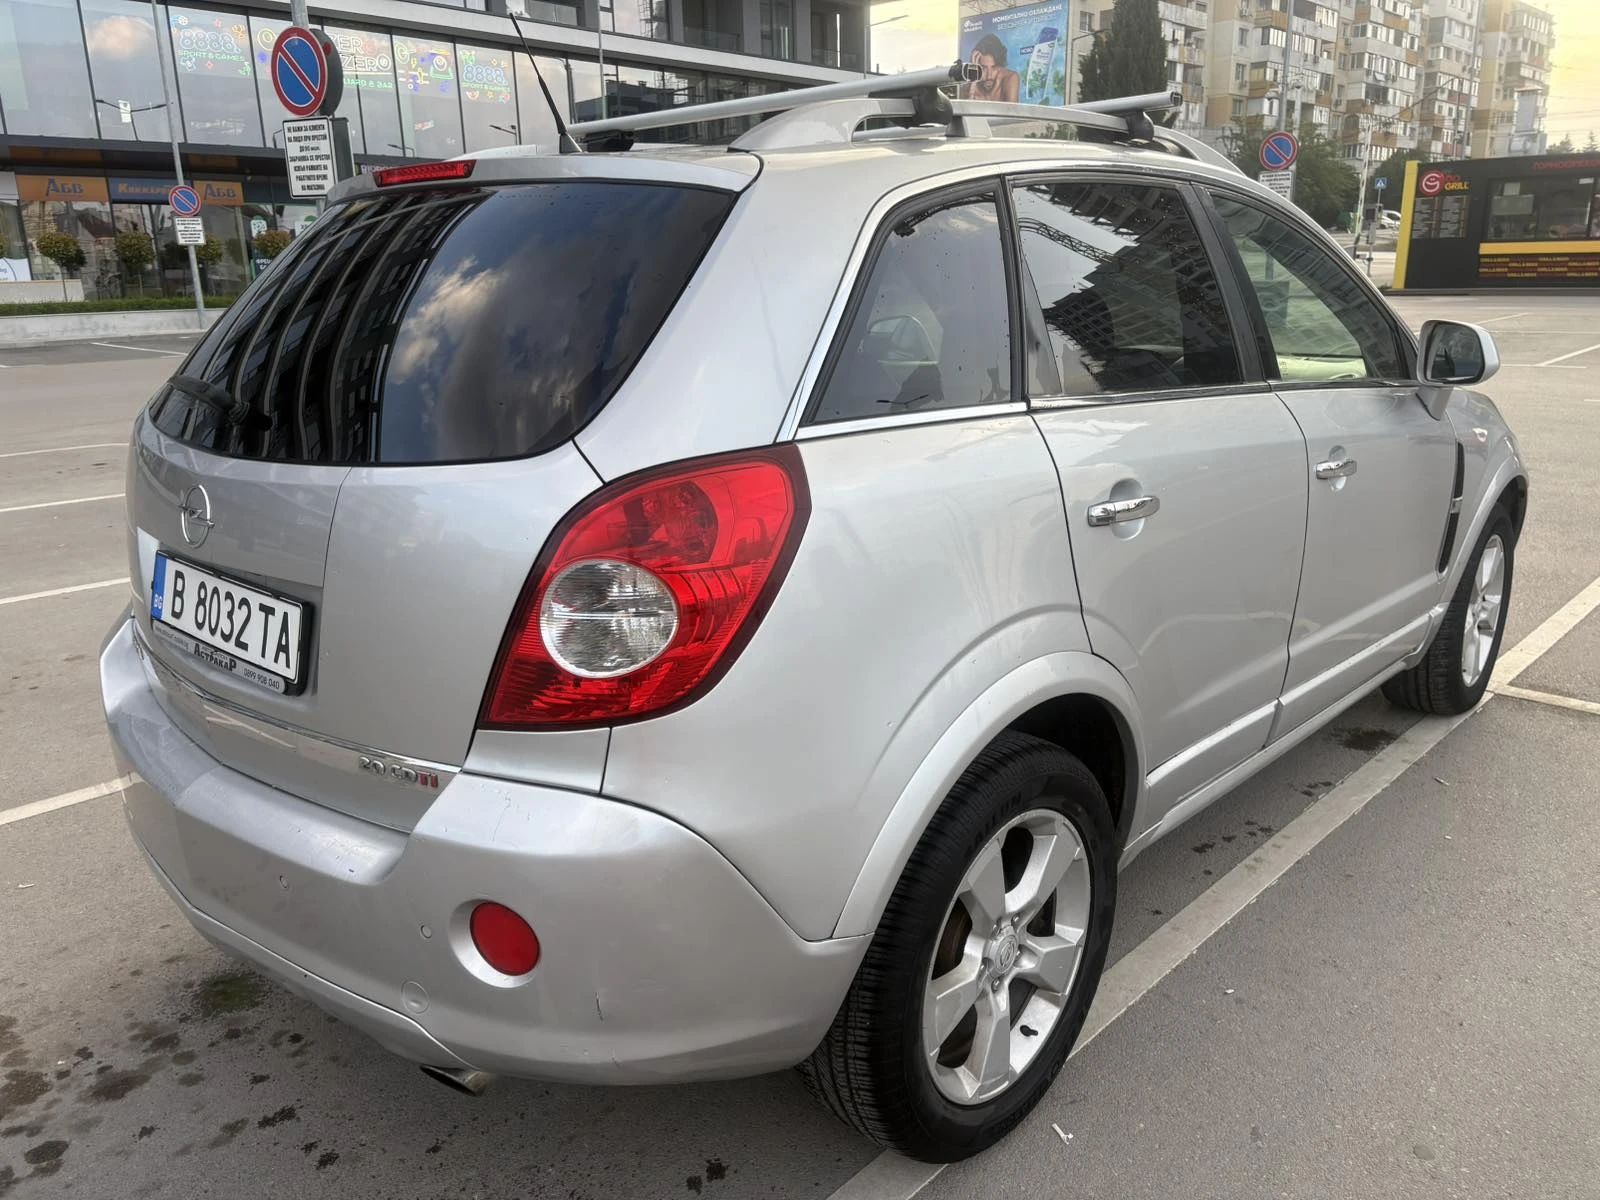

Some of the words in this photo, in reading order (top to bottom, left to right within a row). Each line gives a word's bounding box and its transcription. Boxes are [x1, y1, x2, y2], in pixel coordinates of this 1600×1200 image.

[1444, 181, 1470, 191] GRILL
[154, 594, 162, 609] BG
[171, 570, 185, 619] B
[194, 581, 252, 652] 8032
[258, 603, 290, 669] TA
[244, 668, 256, 679] 0899
[269, 678, 280, 689] 040
